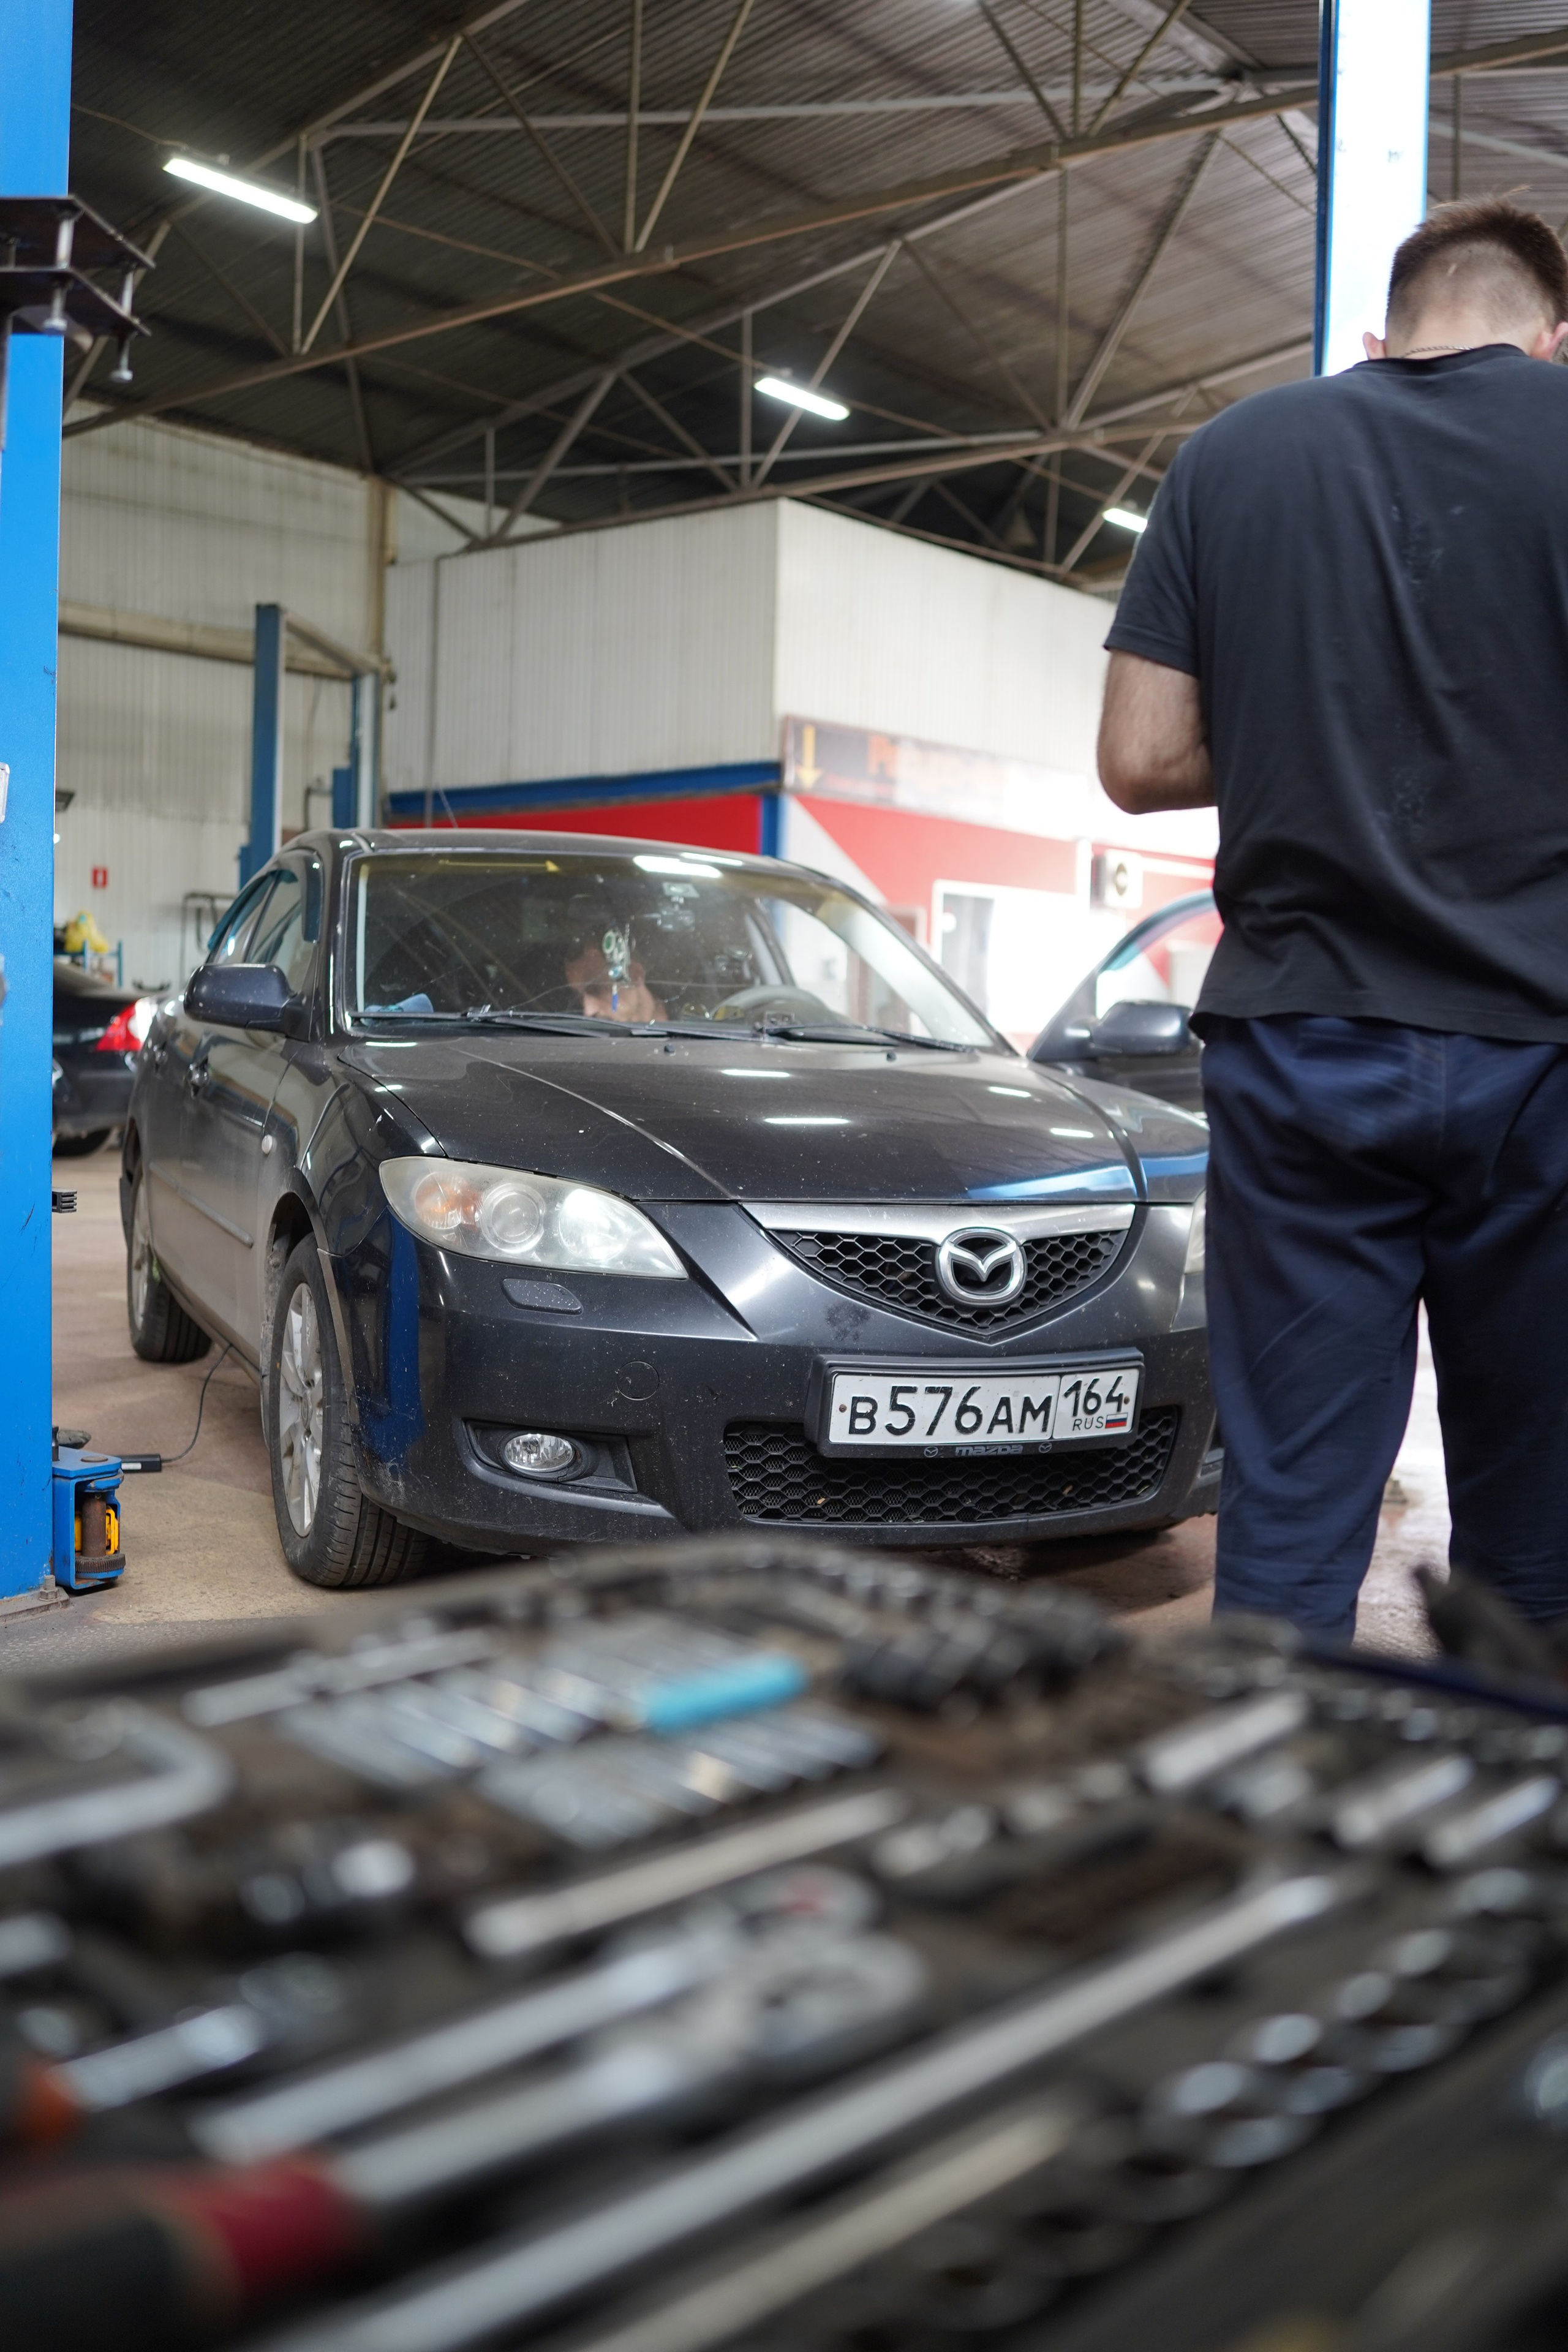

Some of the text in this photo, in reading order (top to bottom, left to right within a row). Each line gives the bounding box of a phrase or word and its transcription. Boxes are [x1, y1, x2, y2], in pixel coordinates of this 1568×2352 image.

[848, 1375, 1124, 1436] В576АМ 164
[1072, 1416, 1104, 1431] RUS
